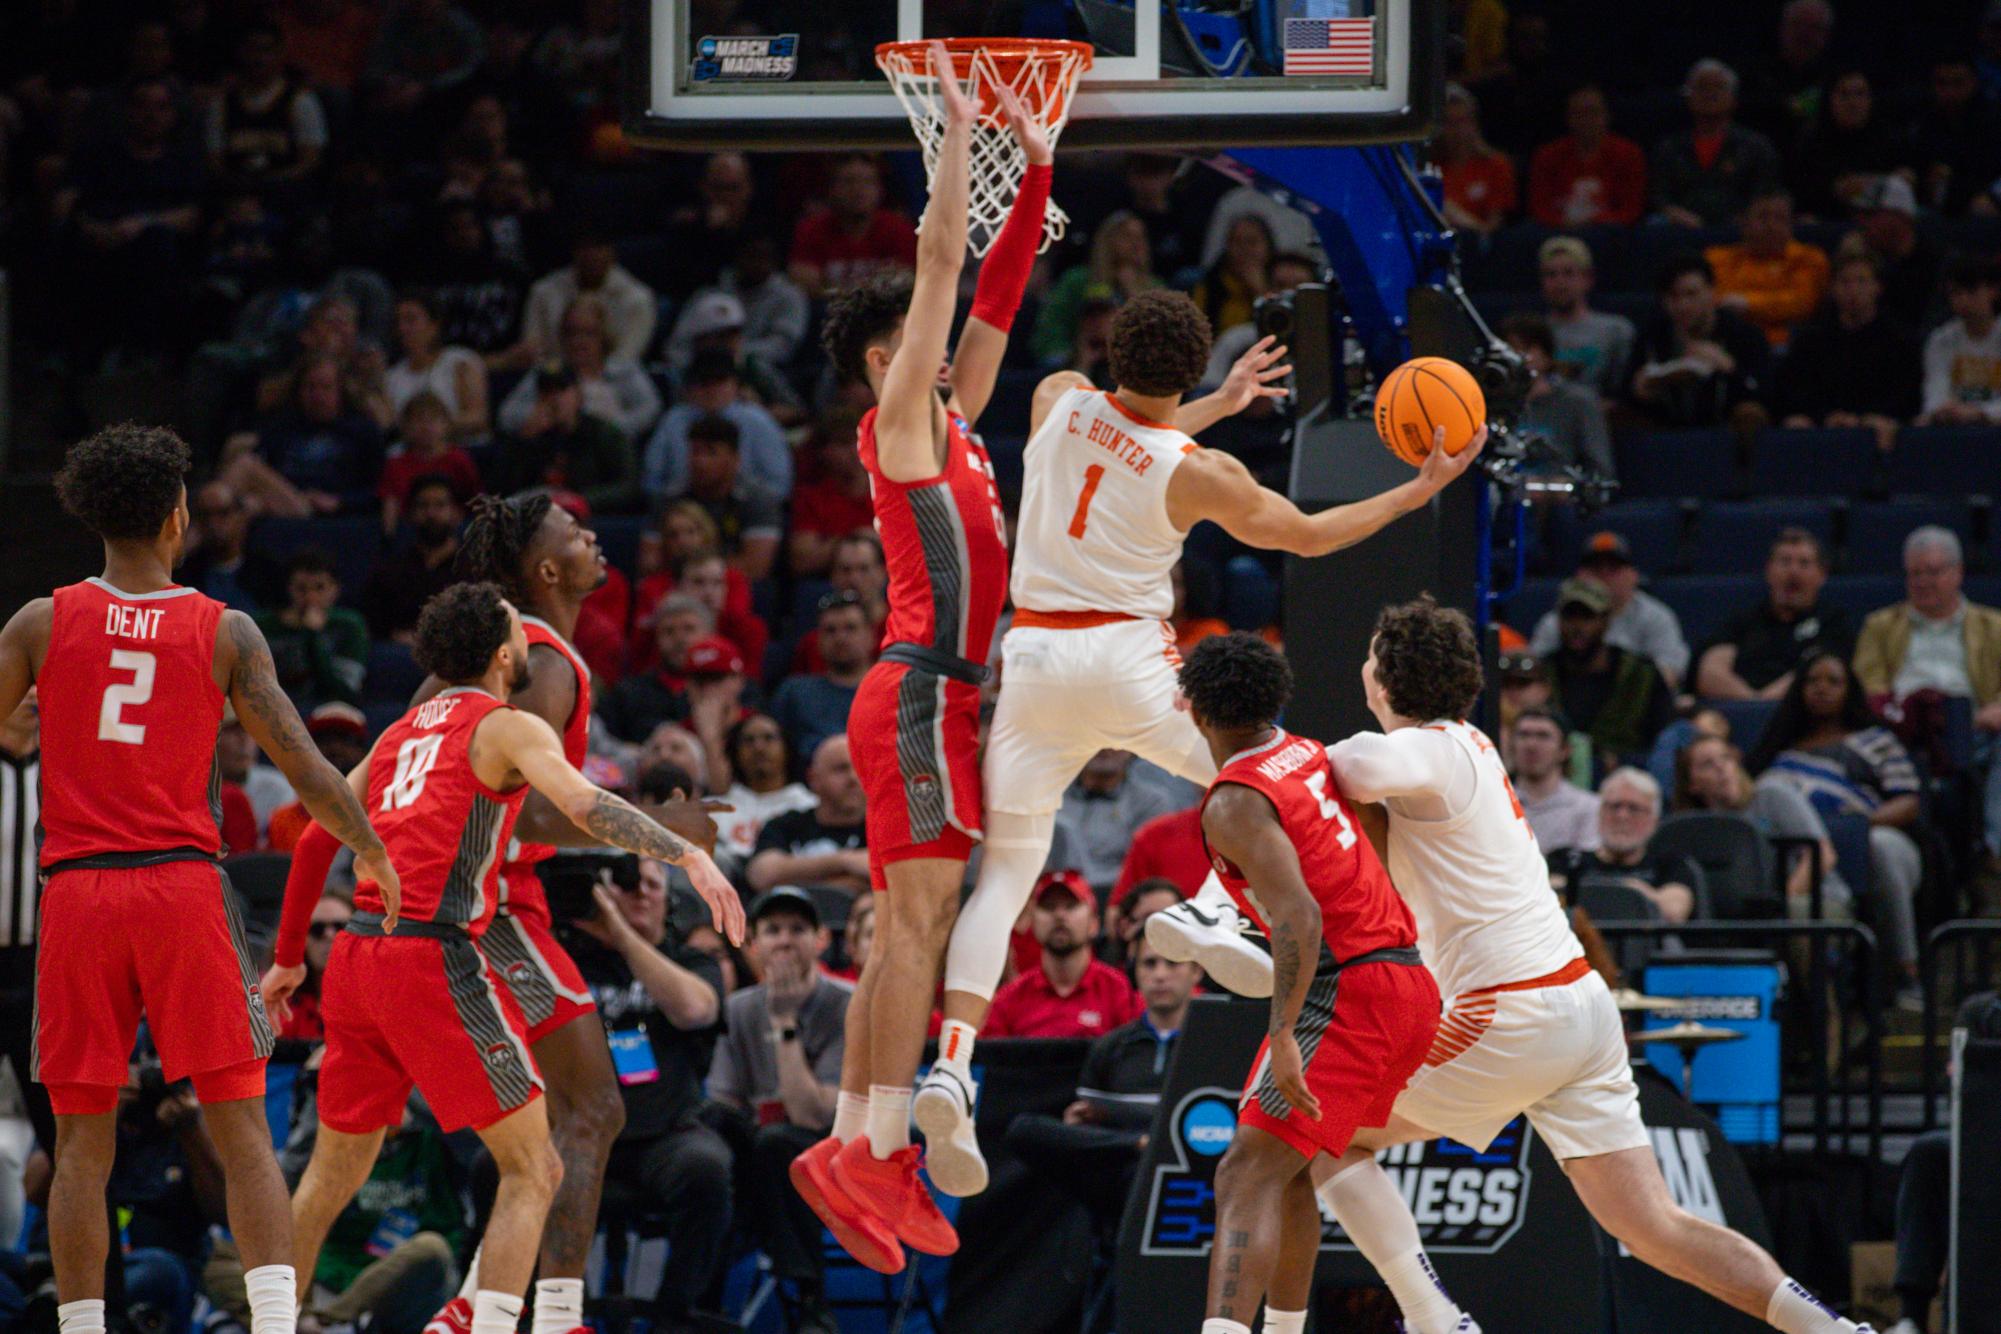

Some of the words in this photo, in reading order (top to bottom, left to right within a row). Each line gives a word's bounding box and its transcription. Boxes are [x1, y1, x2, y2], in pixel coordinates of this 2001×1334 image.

[715, 39, 771, 57] MARCH
[721, 56, 794, 74] MADNESS
[1067, 410, 1081, 436] C.
[1087, 417, 1154, 478] HUNTER
[1067, 463, 1105, 541] 1
[105, 602, 166, 640] DENT
[97, 648, 158, 746] 2
